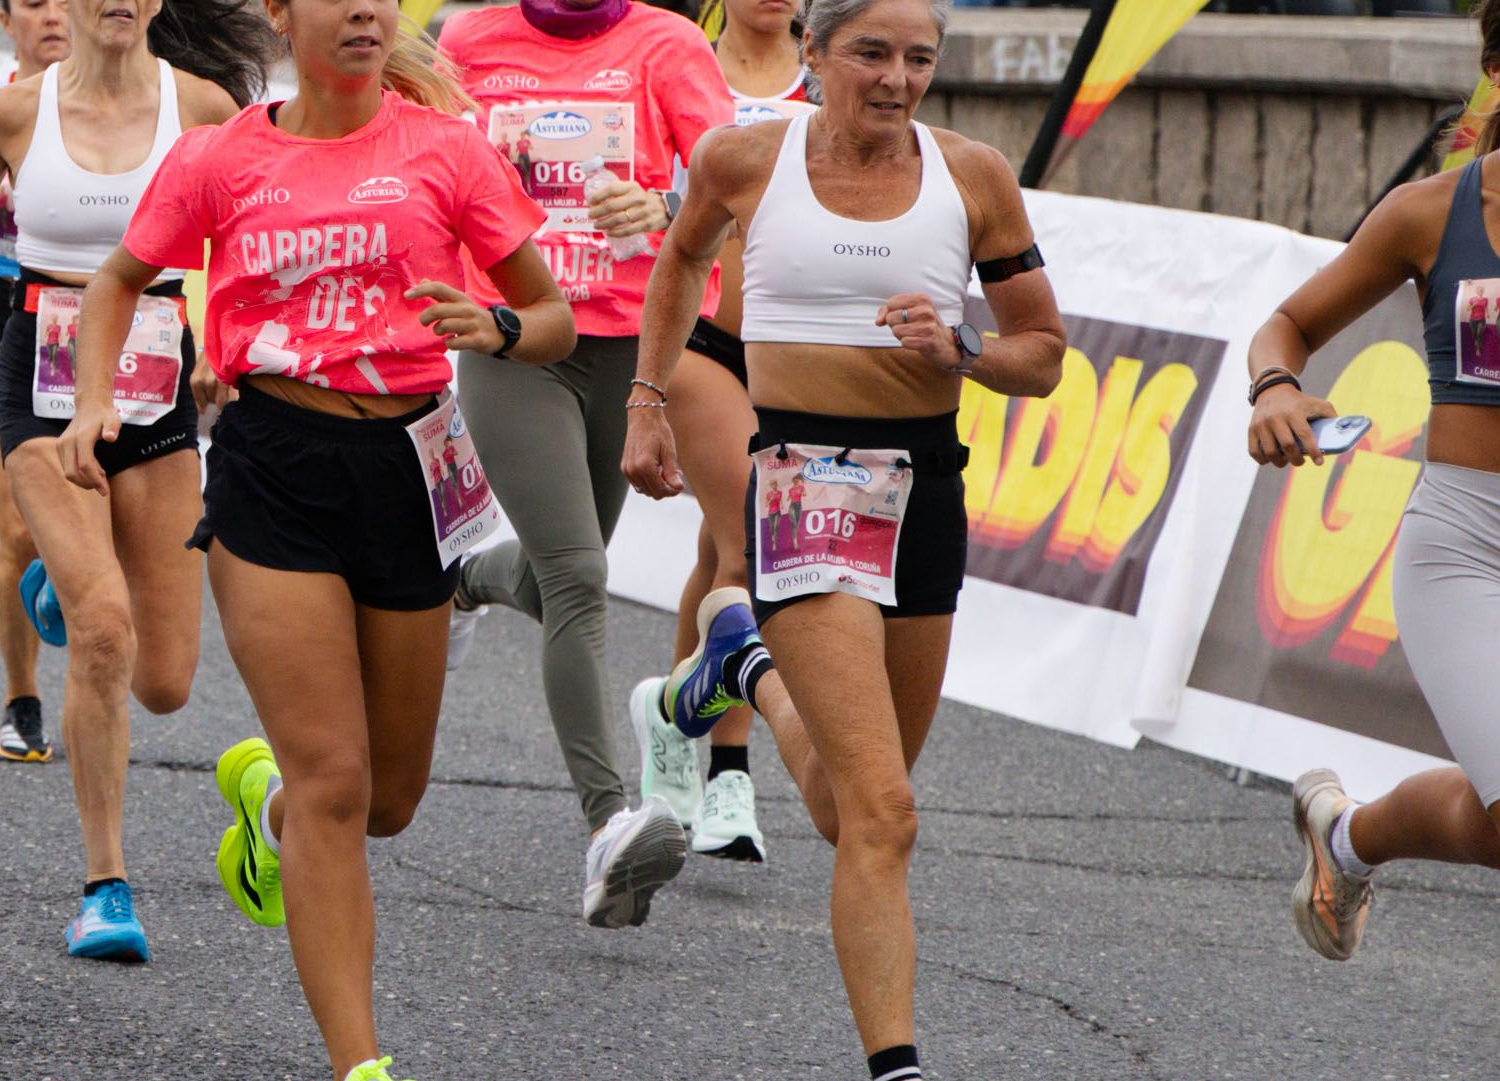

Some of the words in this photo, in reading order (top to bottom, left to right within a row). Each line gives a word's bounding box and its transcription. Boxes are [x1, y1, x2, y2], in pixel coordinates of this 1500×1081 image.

[484, 75, 539, 91] OYSHO
[535, 122, 588, 135] ASTURIANA
[535, 161, 587, 183] 016
[79, 194, 129, 206] OYSHO
[353, 187, 405, 201] ASTURIANA
[241, 223, 388, 275] CARRERA
[833, 243, 891, 258] OYSHO
[543, 245, 614, 282] UJER
[422, 423, 446, 443] SUMA
[462, 454, 483, 490] 01
[766, 458, 798, 471] SUMA
[805, 509, 857, 538] 016
[449, 520, 484, 552] OYSHO
[772, 556, 803, 571] CARRERA
[804, 553, 814, 563] DE
[816, 552, 826, 562] LA
[776, 571, 820, 591] OYSHO
